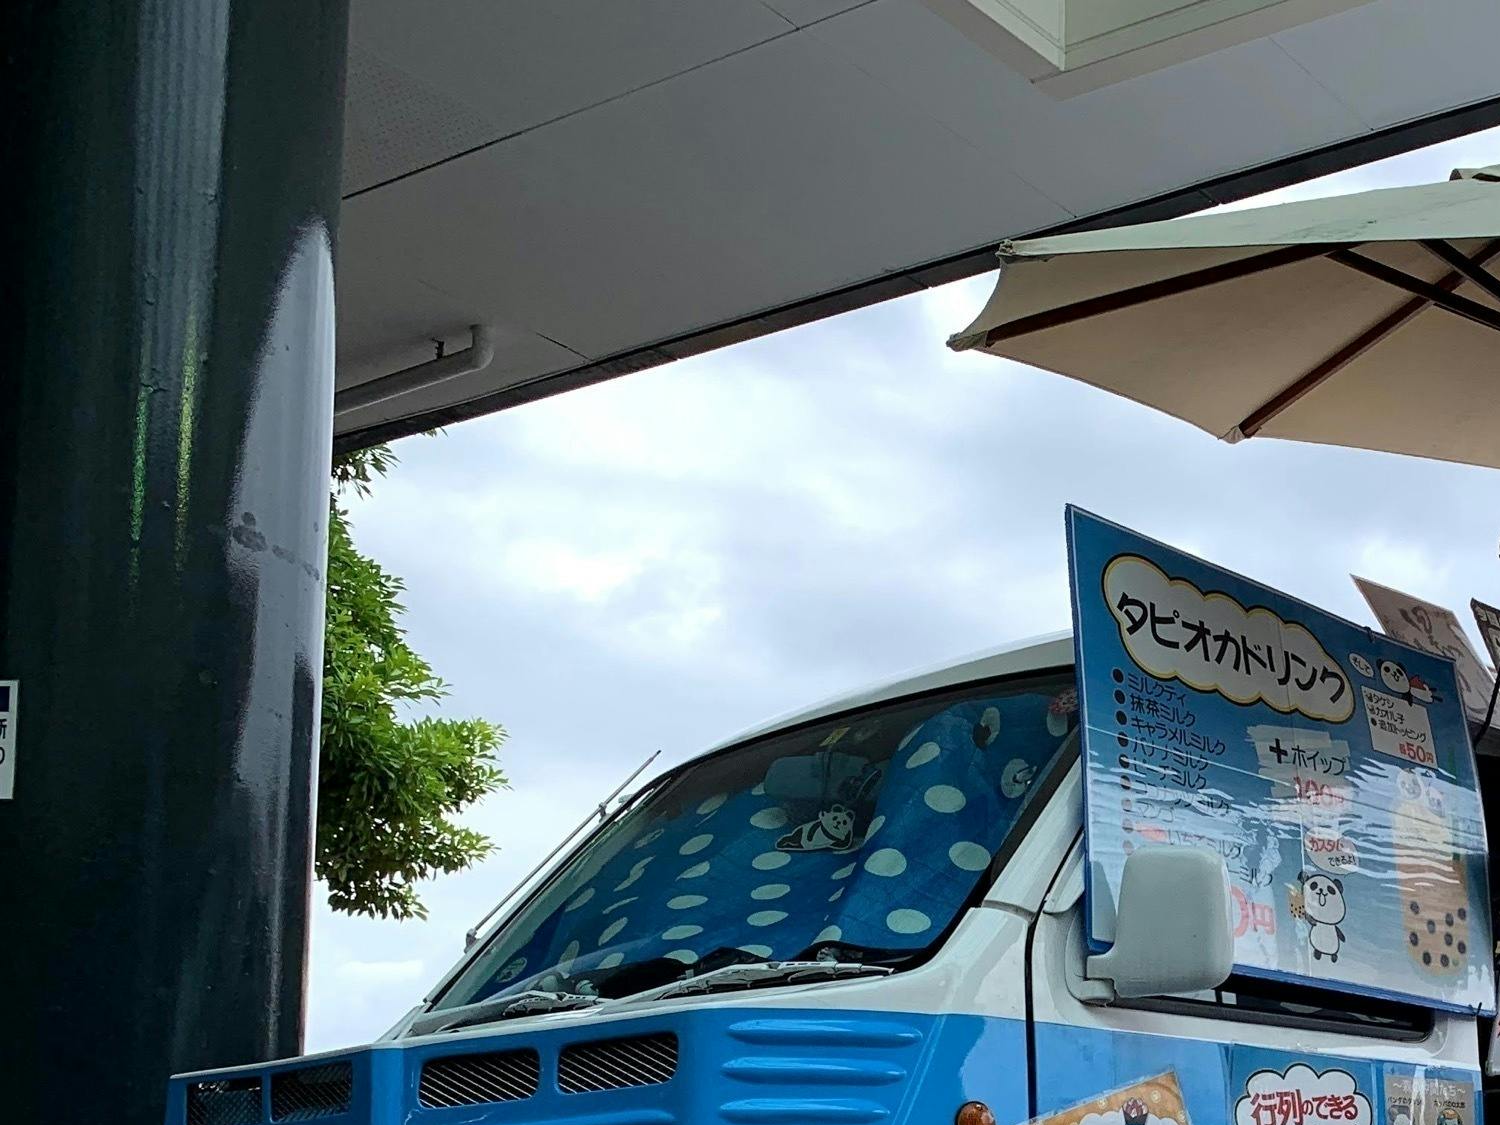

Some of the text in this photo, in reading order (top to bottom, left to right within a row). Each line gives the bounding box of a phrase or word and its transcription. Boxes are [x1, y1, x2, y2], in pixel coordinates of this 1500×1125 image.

[1117, 592, 1346, 703] タピオカドリンク
[1127, 673, 1187, 707] ミルクティ
[1130, 693, 1196, 727] 抹茶ミルク
[1131, 715, 1226, 755] キャラメルミルク
